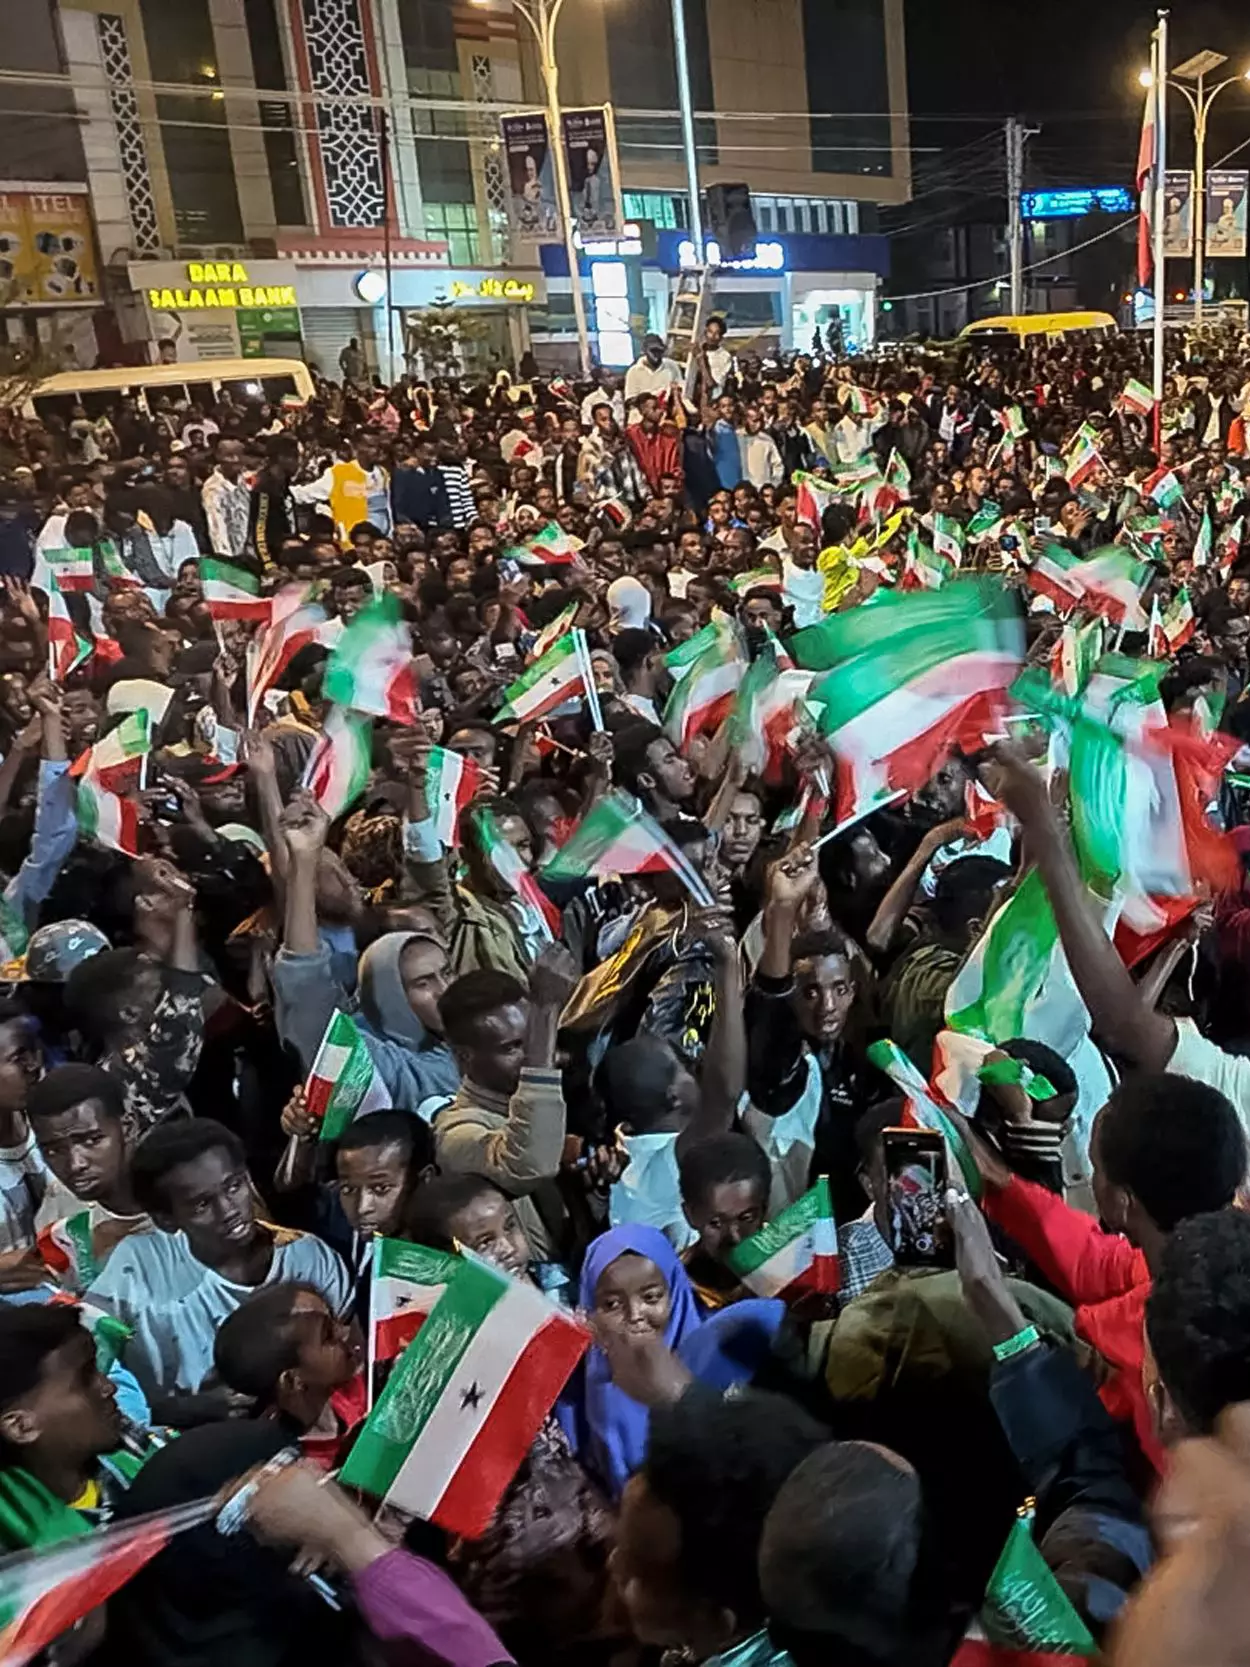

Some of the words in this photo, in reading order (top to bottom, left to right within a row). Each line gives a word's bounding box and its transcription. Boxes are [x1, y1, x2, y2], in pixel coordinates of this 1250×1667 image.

[189, 263, 248, 282] DARA
[149, 288, 237, 308] SALAAM
[239, 286, 296, 306] BANK
